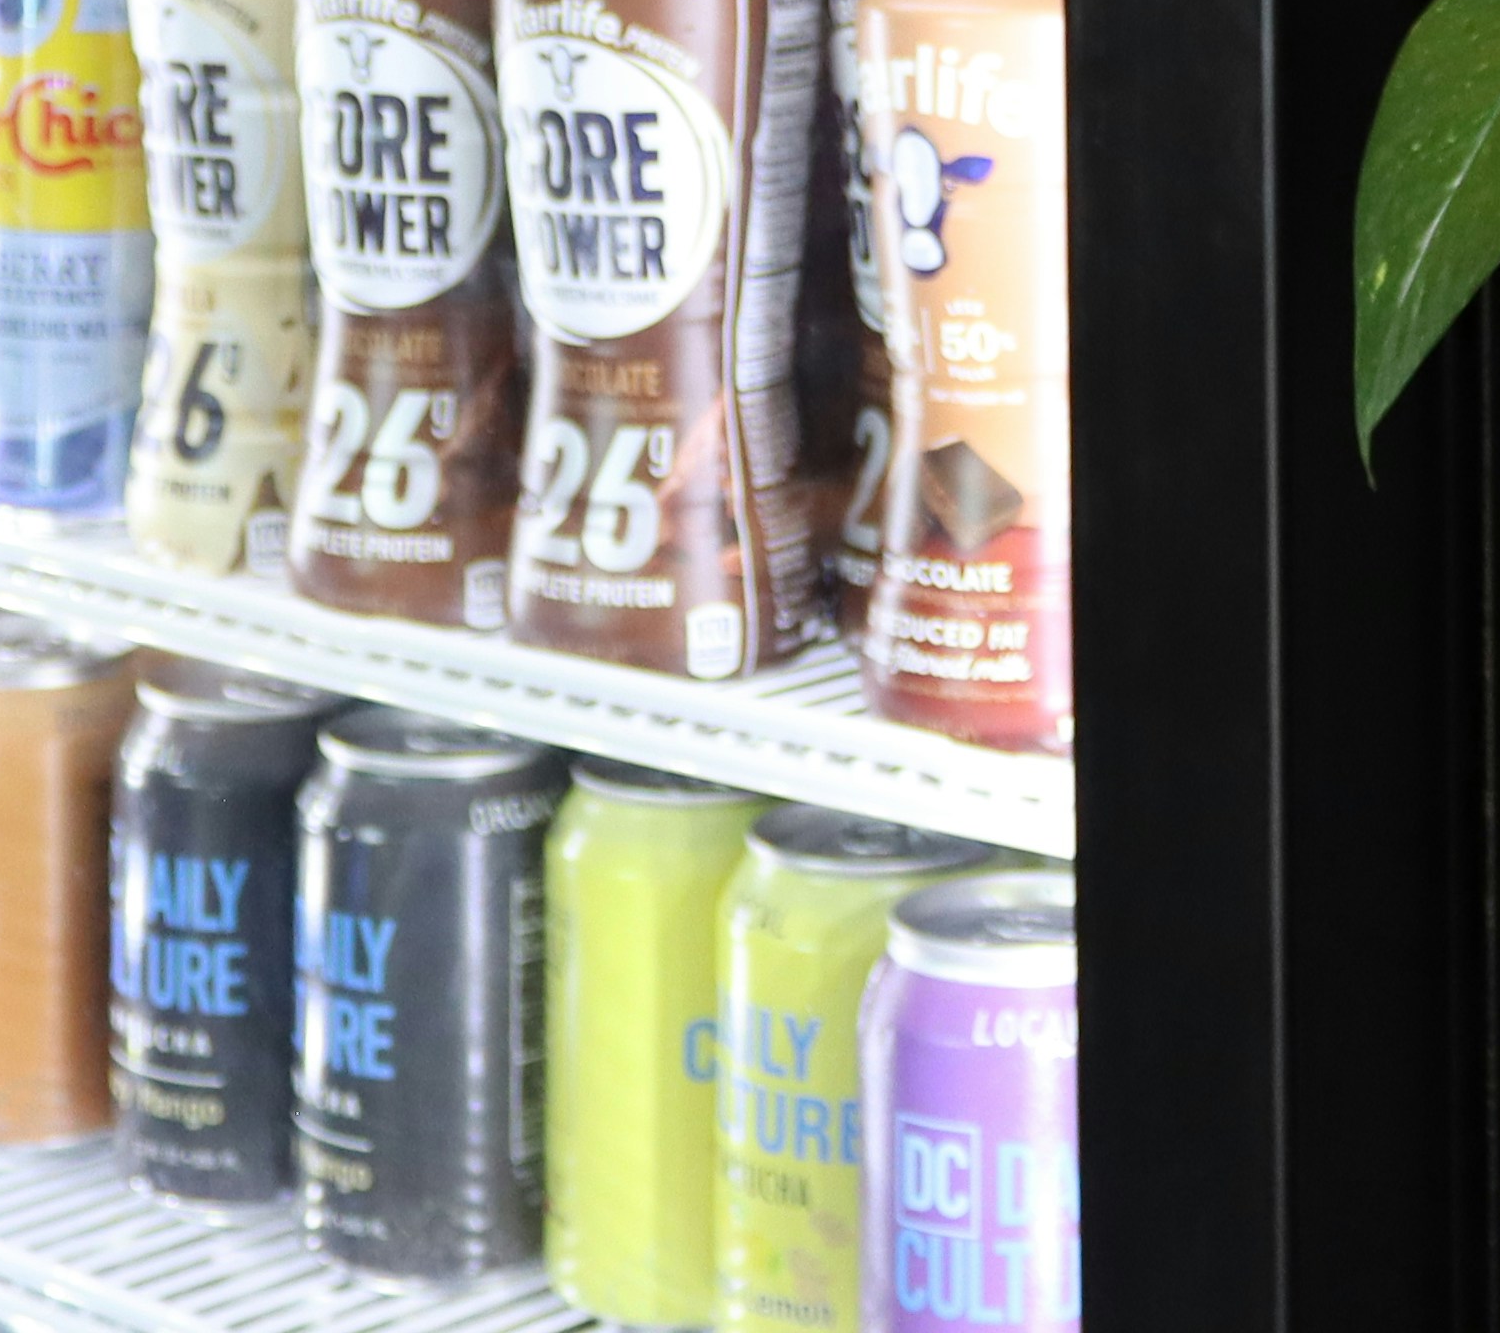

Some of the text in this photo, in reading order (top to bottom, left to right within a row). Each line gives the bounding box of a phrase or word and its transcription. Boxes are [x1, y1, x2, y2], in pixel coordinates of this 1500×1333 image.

[7, 72, 148, 177] Chic
[334, 89, 451, 185] ORE
[539, 109, 664, 204] ORE
[332, 187, 451, 256] OWER
[543, 212, 666, 283] OWER
[364, 535, 454, 563] PROTEIN
[583, 577, 675, 609] PROTEIN
[145, 852, 251, 934] AILY
[903, 1132, 970, 1221] DC
[896, 1230, 1083, 1326] CULT
